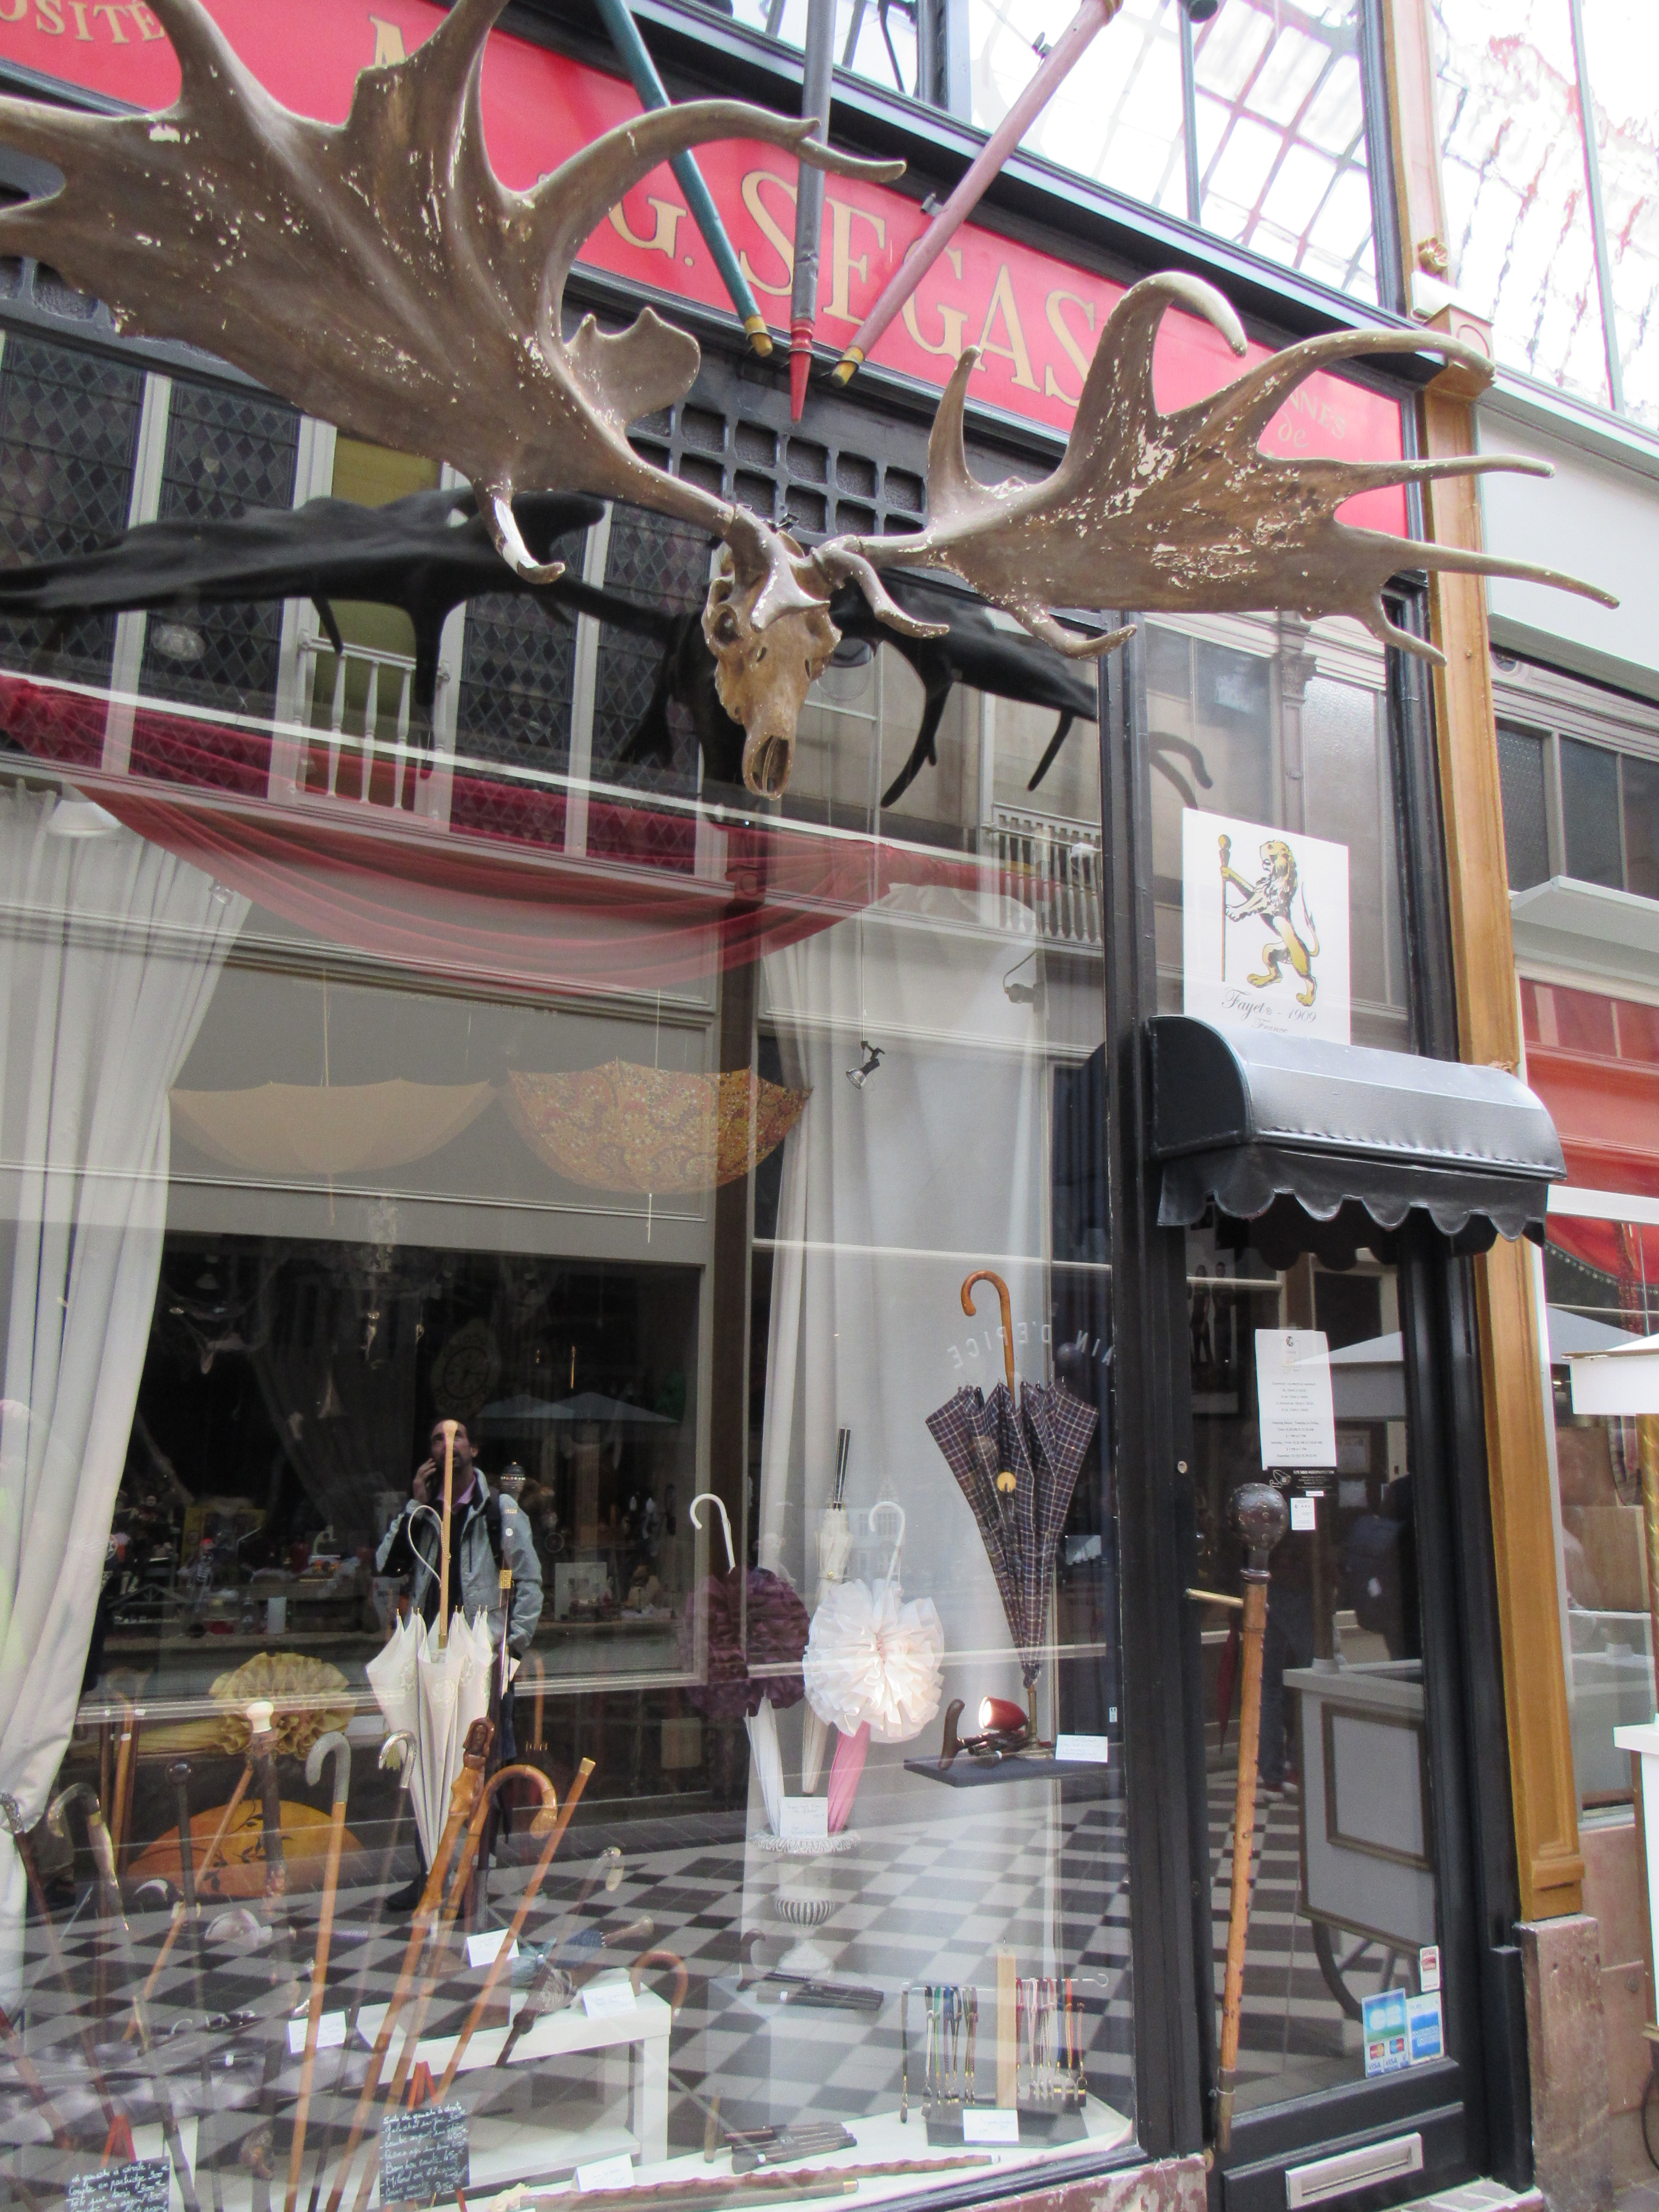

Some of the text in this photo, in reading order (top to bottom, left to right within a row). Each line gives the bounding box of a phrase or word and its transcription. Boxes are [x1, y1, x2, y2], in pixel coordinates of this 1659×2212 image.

[739, 169, 1096, 408] SEGAS
[1288, 1009, 1316, 1023] 1909
[1251, 1017, 1288, 1033] France
